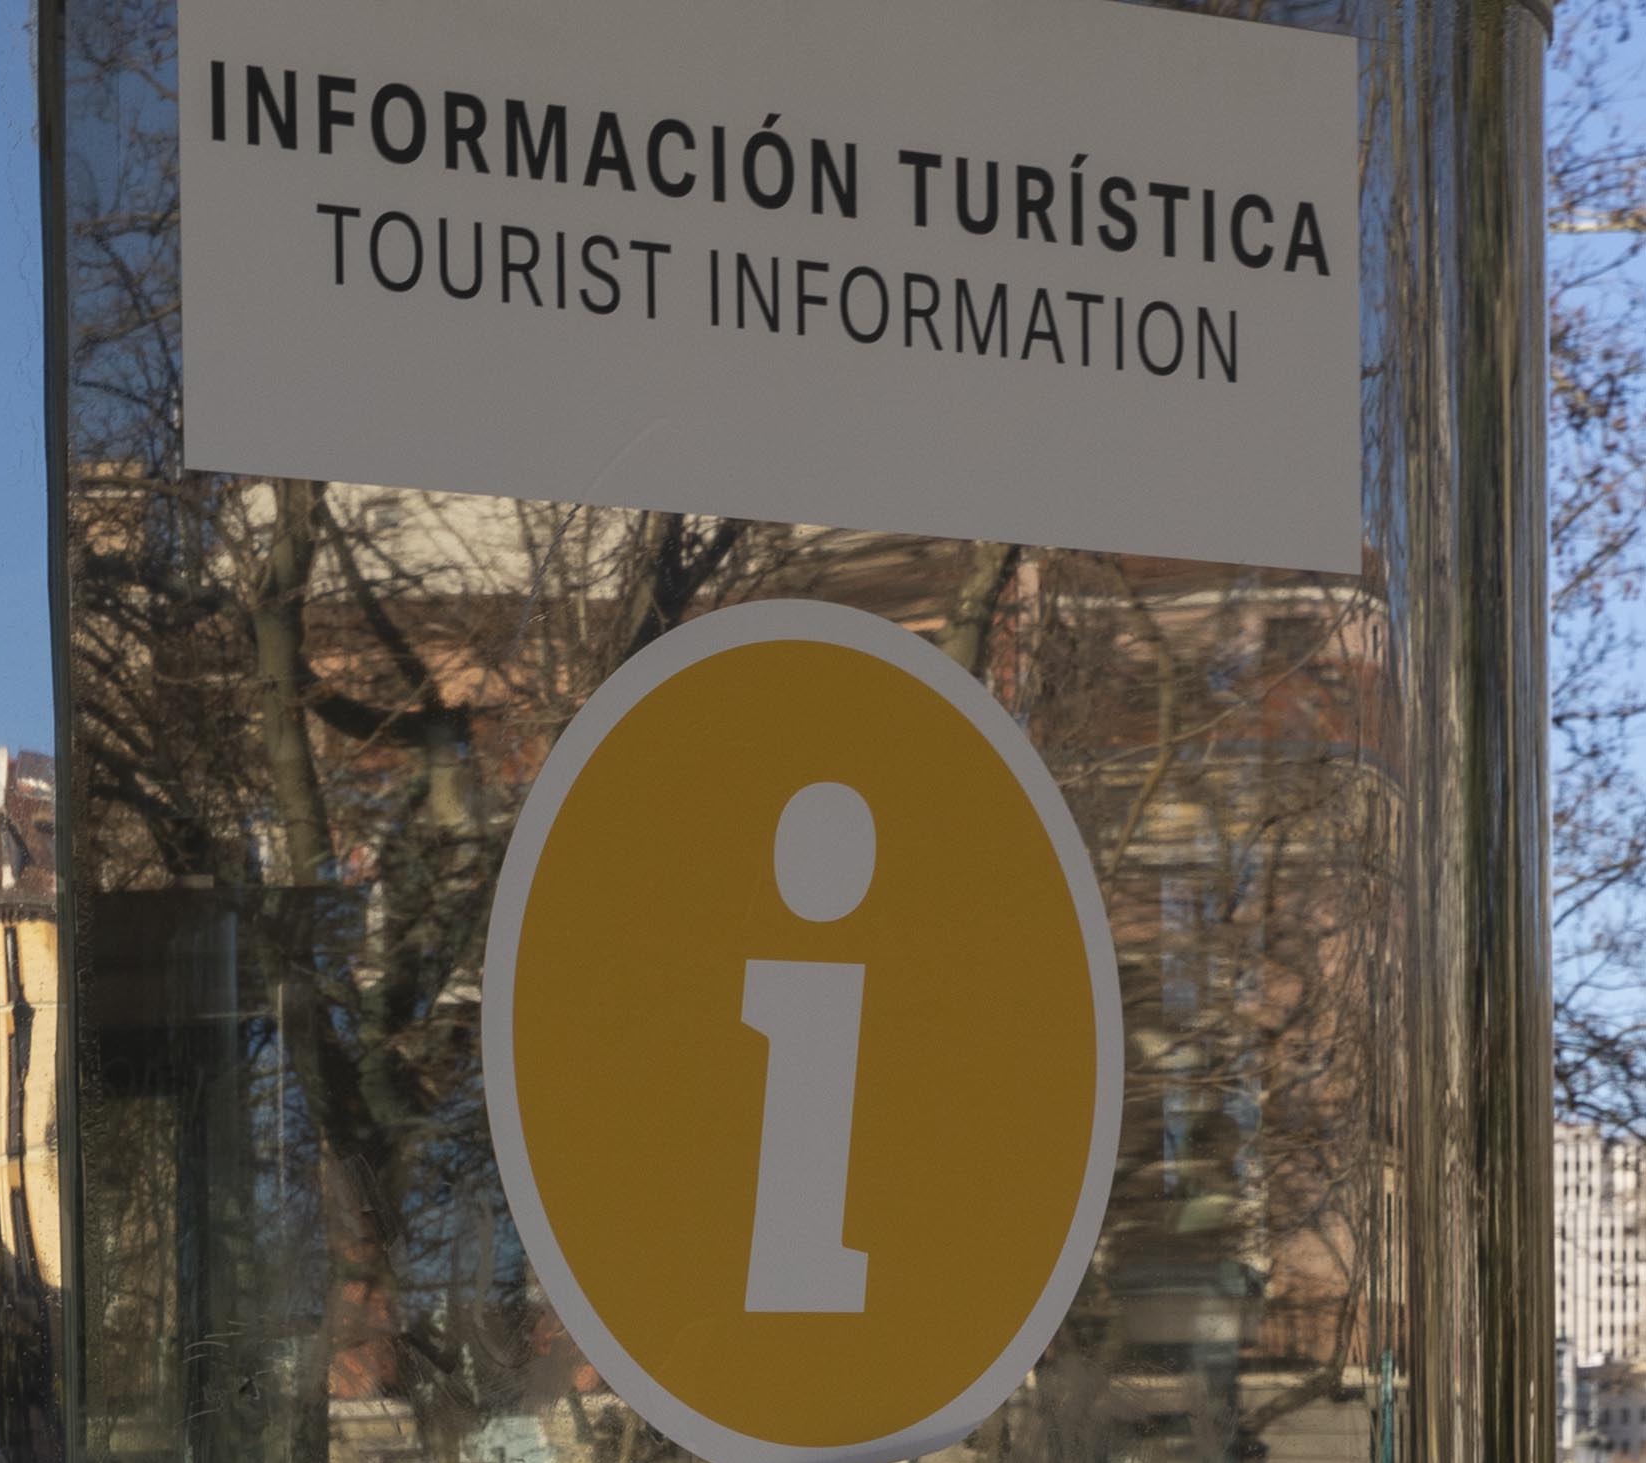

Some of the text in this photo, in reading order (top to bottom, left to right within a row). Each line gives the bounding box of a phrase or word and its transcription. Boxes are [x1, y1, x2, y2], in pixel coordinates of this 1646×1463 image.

[211, 61, 1330, 276] INFORMACIÓN TURÍSTICA
[317, 204, 1236, 383] TOURIST INFORMATION
